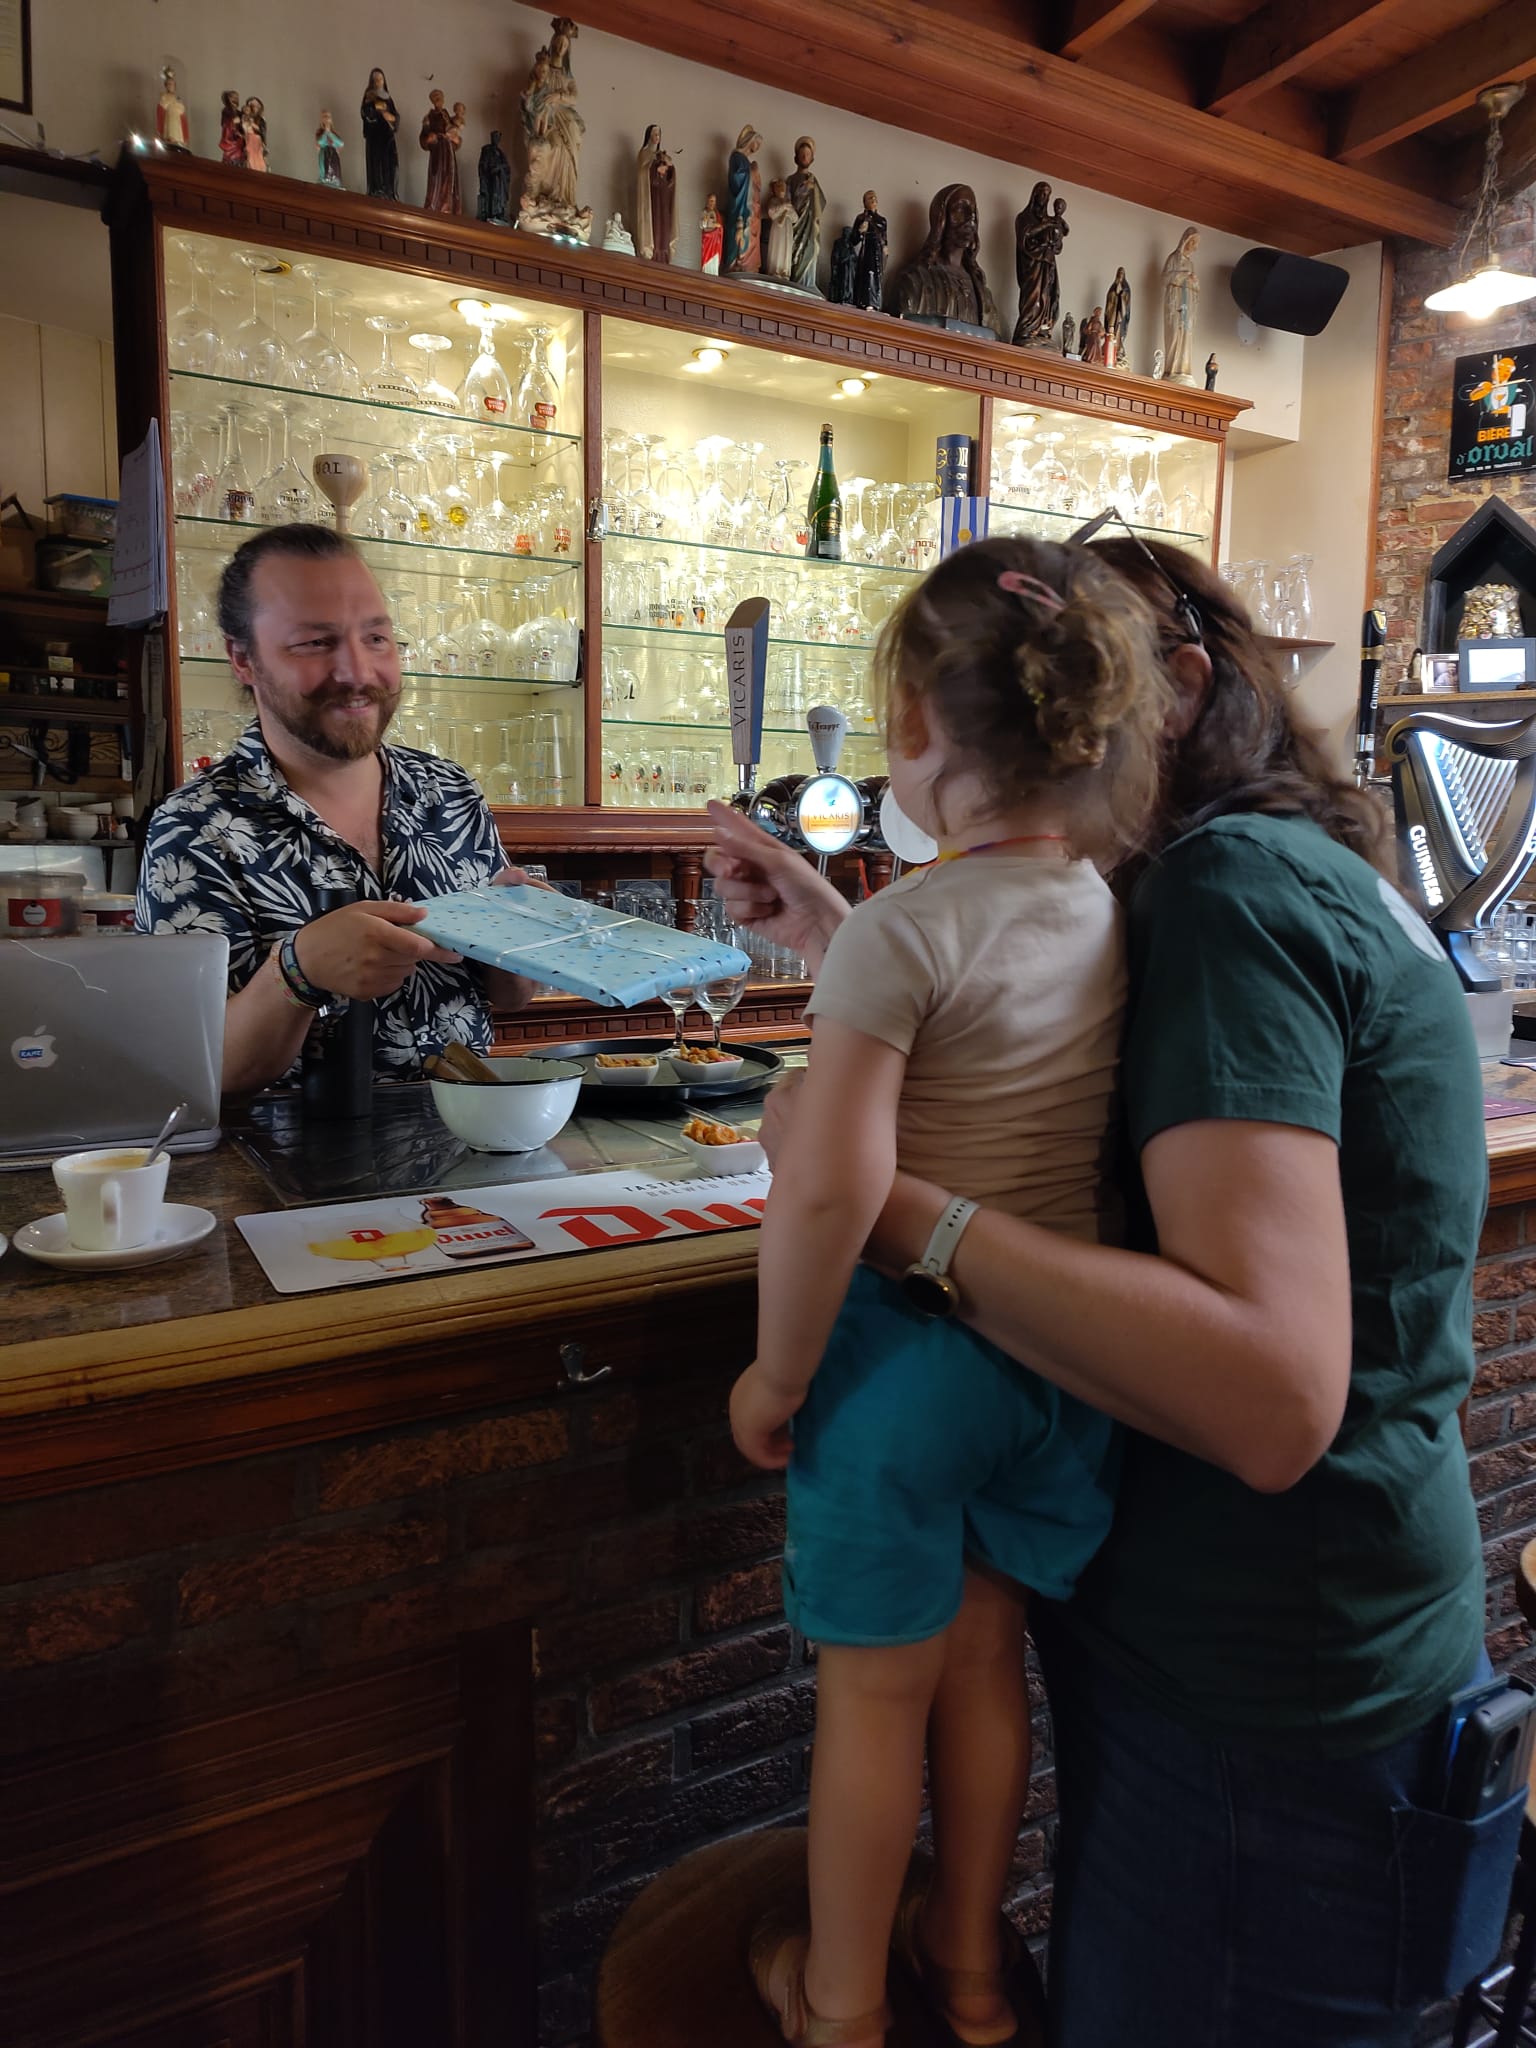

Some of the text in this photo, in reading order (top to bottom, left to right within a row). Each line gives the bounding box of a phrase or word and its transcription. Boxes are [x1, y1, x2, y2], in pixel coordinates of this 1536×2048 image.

[732, 635, 746, 728] VICARIS
[1409, 824, 1444, 907] GUINNESS
[436, 1225, 518, 1244] Duvel
